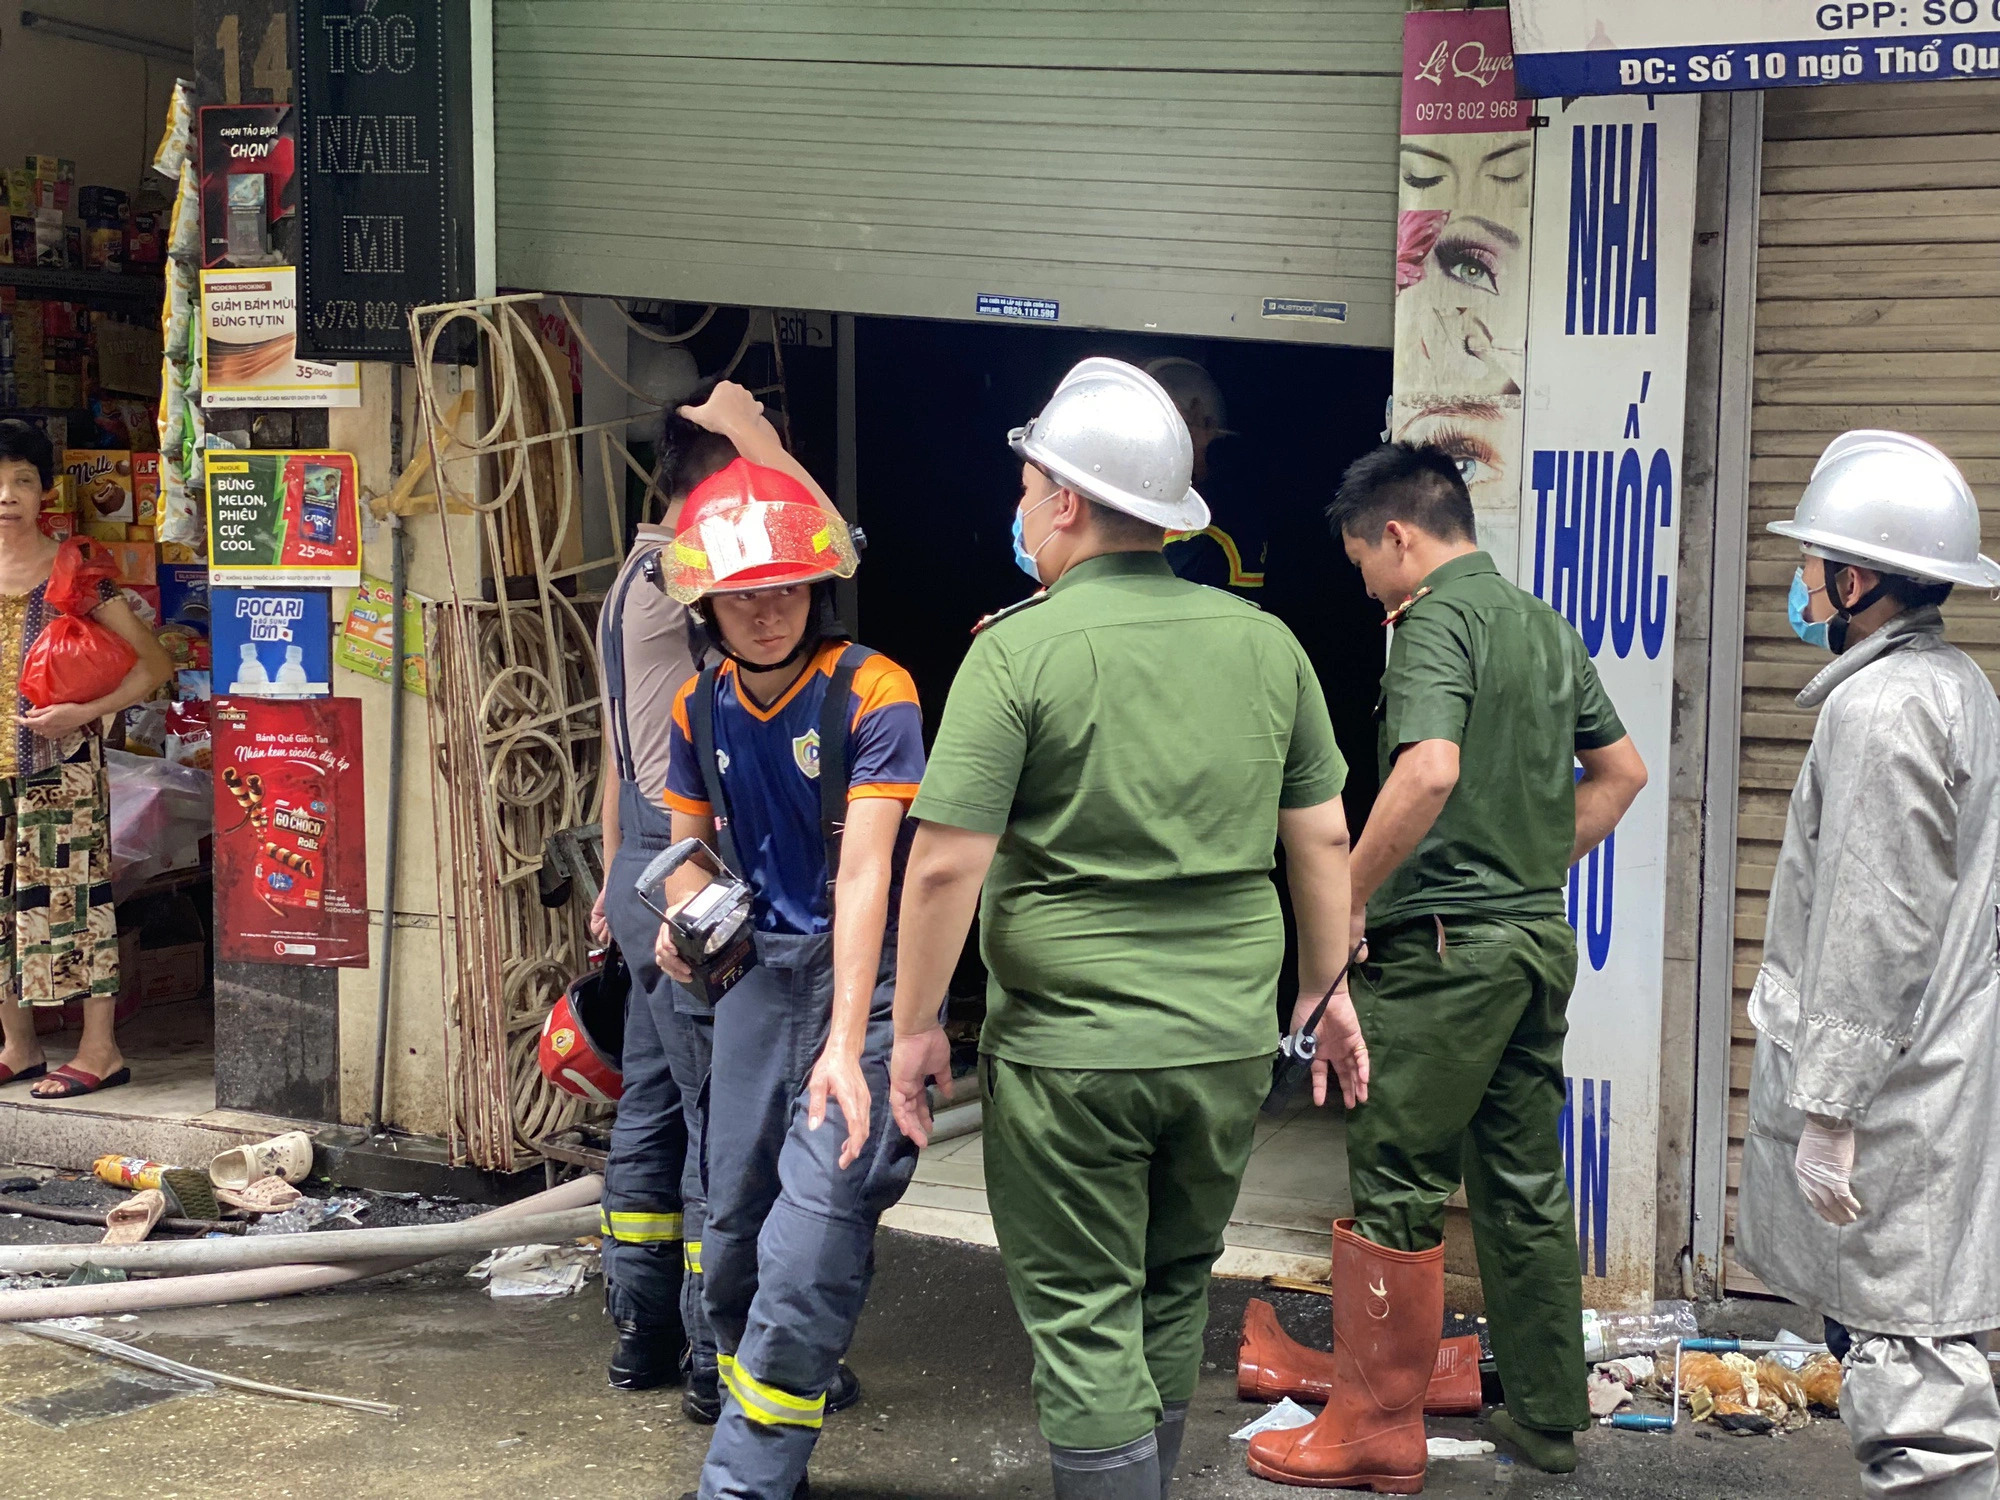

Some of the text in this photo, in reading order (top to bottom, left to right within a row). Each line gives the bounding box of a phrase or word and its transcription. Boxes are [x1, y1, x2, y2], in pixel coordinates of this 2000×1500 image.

[1816, 2, 1908, 31] GPP:
[215, 13, 292, 104] 14
[1414, 40, 1514, 87] Lê Quyê
[1619, 58, 1677, 86] ĐC:
[1688, 50, 1735, 83] Số
[1745, 52, 1786, 80] 10
[1798, 45, 1863, 80] ngõ
[1874, 39, 1942, 74] Thổ
[1416, 100, 1518, 121] 0973 802 968
[220, 127, 241, 139] CHỌN
[230, 143, 268, 162] CHỌN
[316, 115, 430, 174] NAIL
[343, 215, 405, 273] MI
[211, 297, 242, 312] GIẢM
[212, 314, 285, 328] BỪNG TỰ TIN
[365, 301, 400, 330] 802
[217, 478, 255, 491] BỪNG
[218, 495, 267, 508] MELON,
[219, 507, 258, 521] PHIÊU
[304, 514, 333, 527] CAMEL
[219, 523, 245, 539] CỰC
[220, 540, 256, 551] COOL
[237, 599, 302, 617] POCARI
[365, 610, 378, 622] 10
[255, 733, 329, 744] Bánh Quế Giòn Tan
[234, 745, 267, 762] Nhân
[267, 744, 287, 757] kem
[288, 745, 318, 760] sôcôla
[275, 812, 322, 836] GO CHOCO
[297, 837, 319, 850] Rollz
